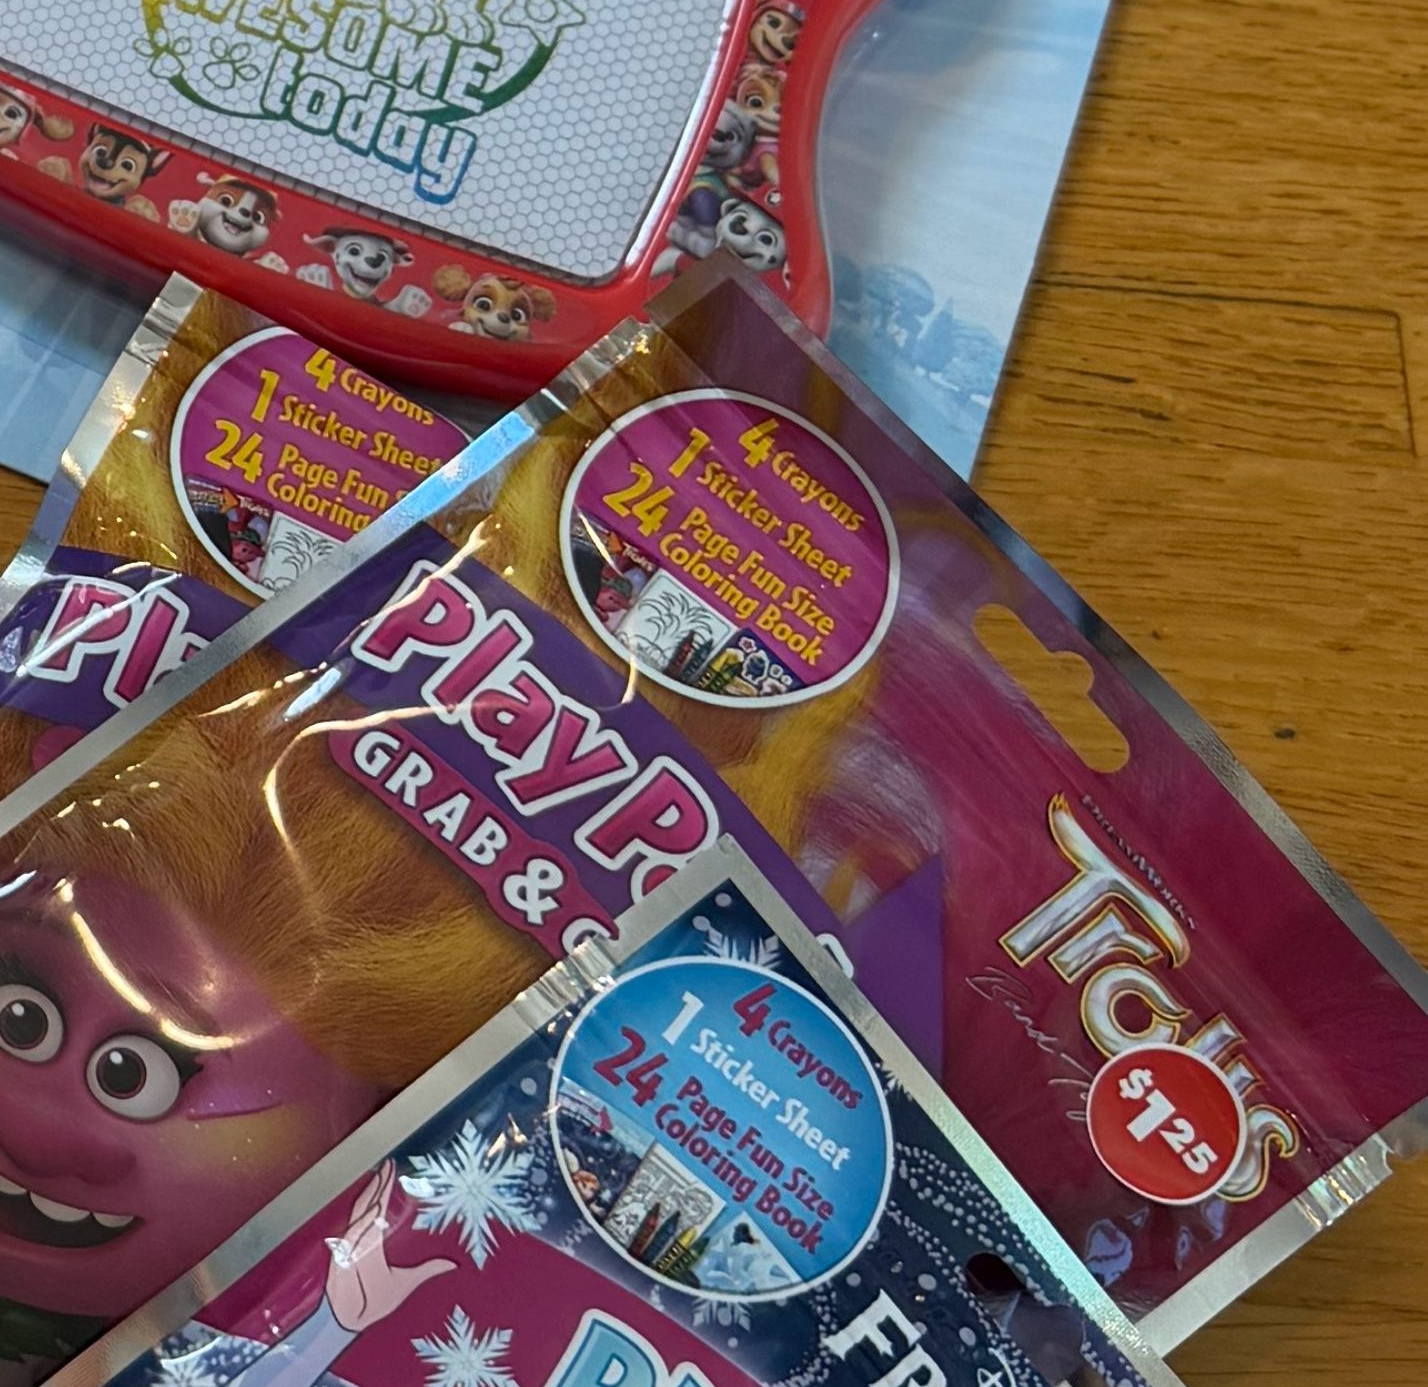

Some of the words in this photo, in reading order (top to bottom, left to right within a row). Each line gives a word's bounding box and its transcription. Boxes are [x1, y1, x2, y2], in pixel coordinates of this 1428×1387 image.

[261, 46, 479, 206] today
[204, 419, 266, 484] 24
[277, 445, 340, 493] Page
[341, 468, 390, 510] Fun
[251, 369, 280, 425] 1
[278, 394, 368, 451] Sticker
[305, 348, 338, 393] 4
[339, 366, 435, 427] Crayons
[602, 461, 675, 539] 24
[680, 506, 742, 567] Page
[741, 549, 786, 601] Fun
[780, 581, 837, 638] Size
[667, 426, 712, 479] 1
[695, 460, 783, 536] Sticker
[782, 520, 854, 590] Sheet
[738, 417, 781, 470] 4
[770, 449, 866, 533] Crayons
[658, 531, 760, 621] Coloring
[756, 606, 826, 668] Book
[359, 566, 634, 814] Play
[351, 730, 509, 867] GRAB
[502, 859, 565, 924] &
[592, 1025, 671, 1108] 24
[676, 1075, 737, 1142] Page
[735, 1125, 784, 1179] Fun
[782, 1166, 836, 1222] Size
[661, 990, 705, 1046] 1
[690, 1027, 781, 1111] Sticker
[775, 1098, 852, 1172] Sheet
[732, 982, 778, 1038] 4
[767, 1018, 863, 1111] Crayons
[654, 1103, 757, 1203] Coloring
[754, 1184, 826, 1257] Book
